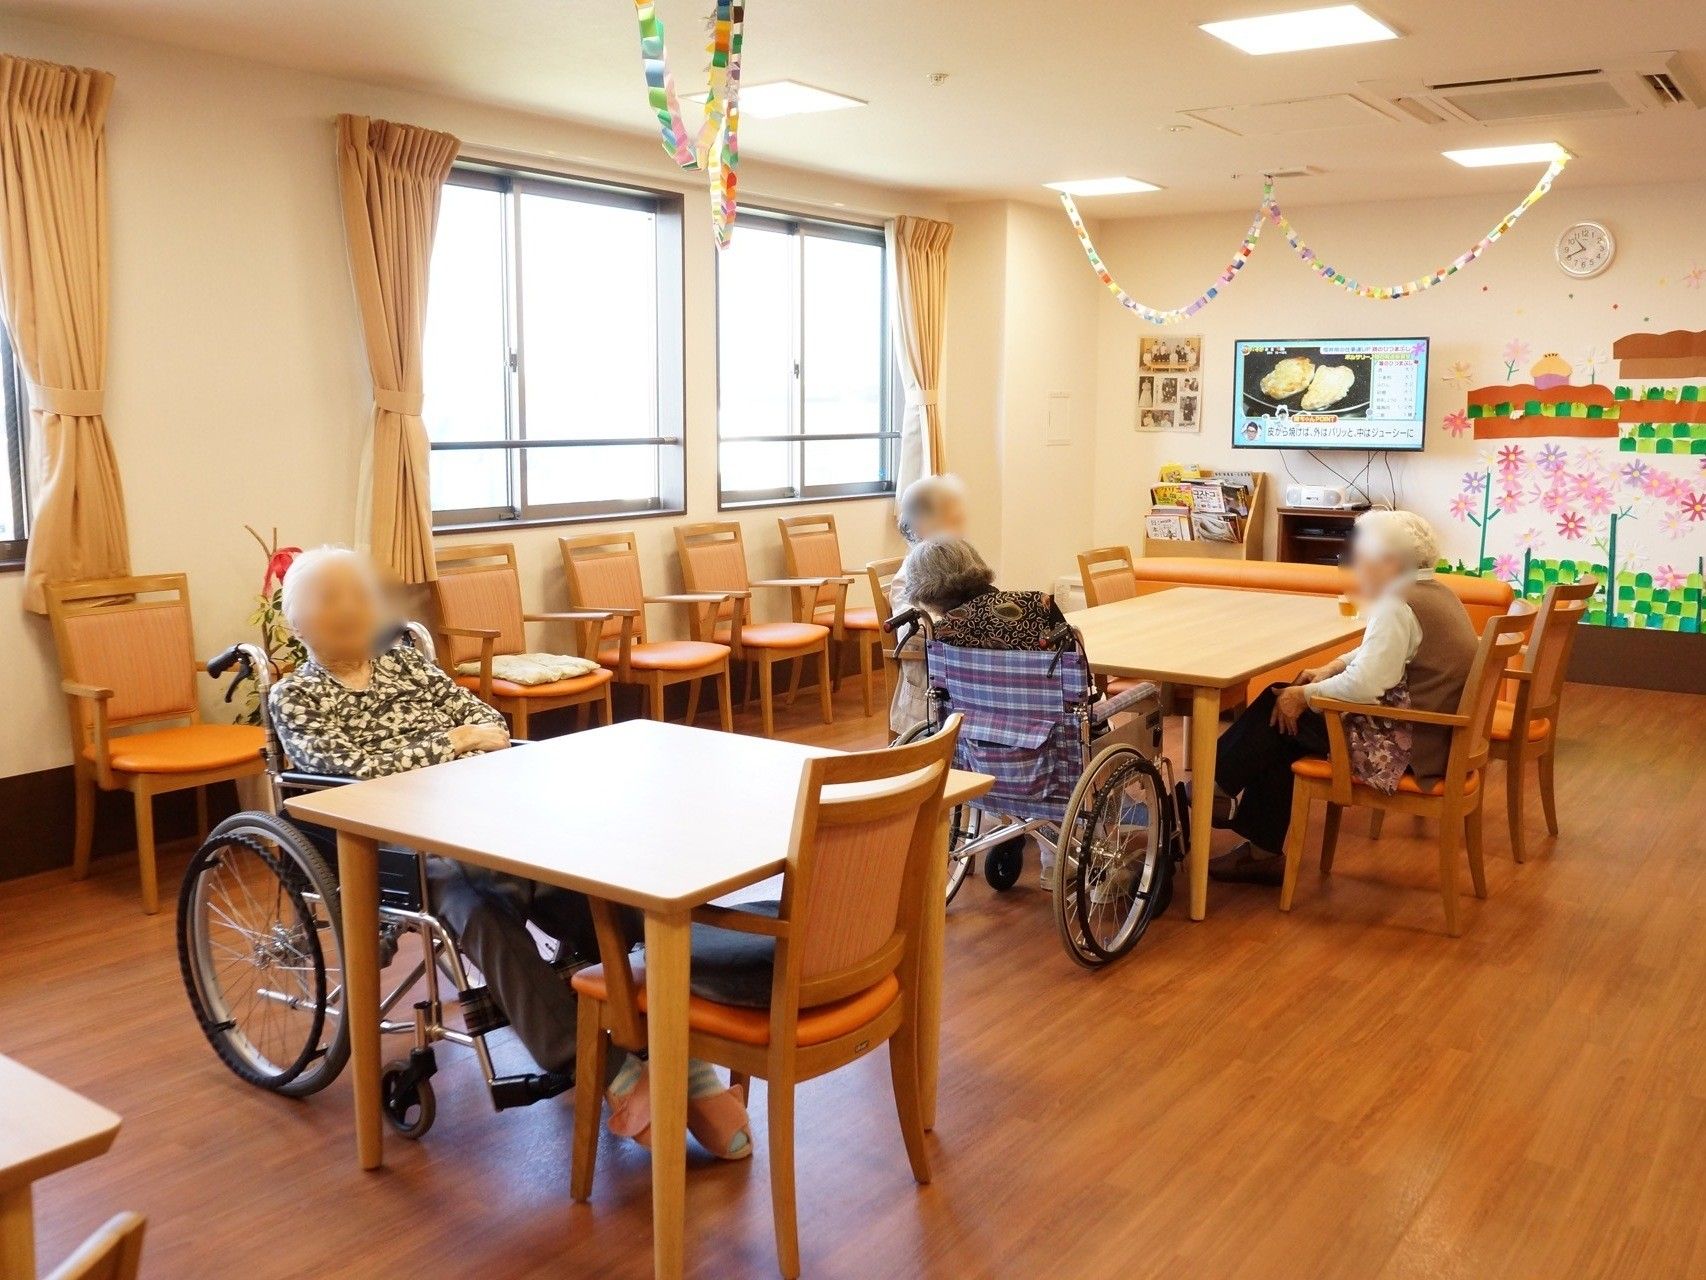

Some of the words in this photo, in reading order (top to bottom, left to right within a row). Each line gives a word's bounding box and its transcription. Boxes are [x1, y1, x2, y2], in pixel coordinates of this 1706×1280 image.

[1581, 229, 1589, 237] 12
[1193, 489, 1216, 498] コストコ
